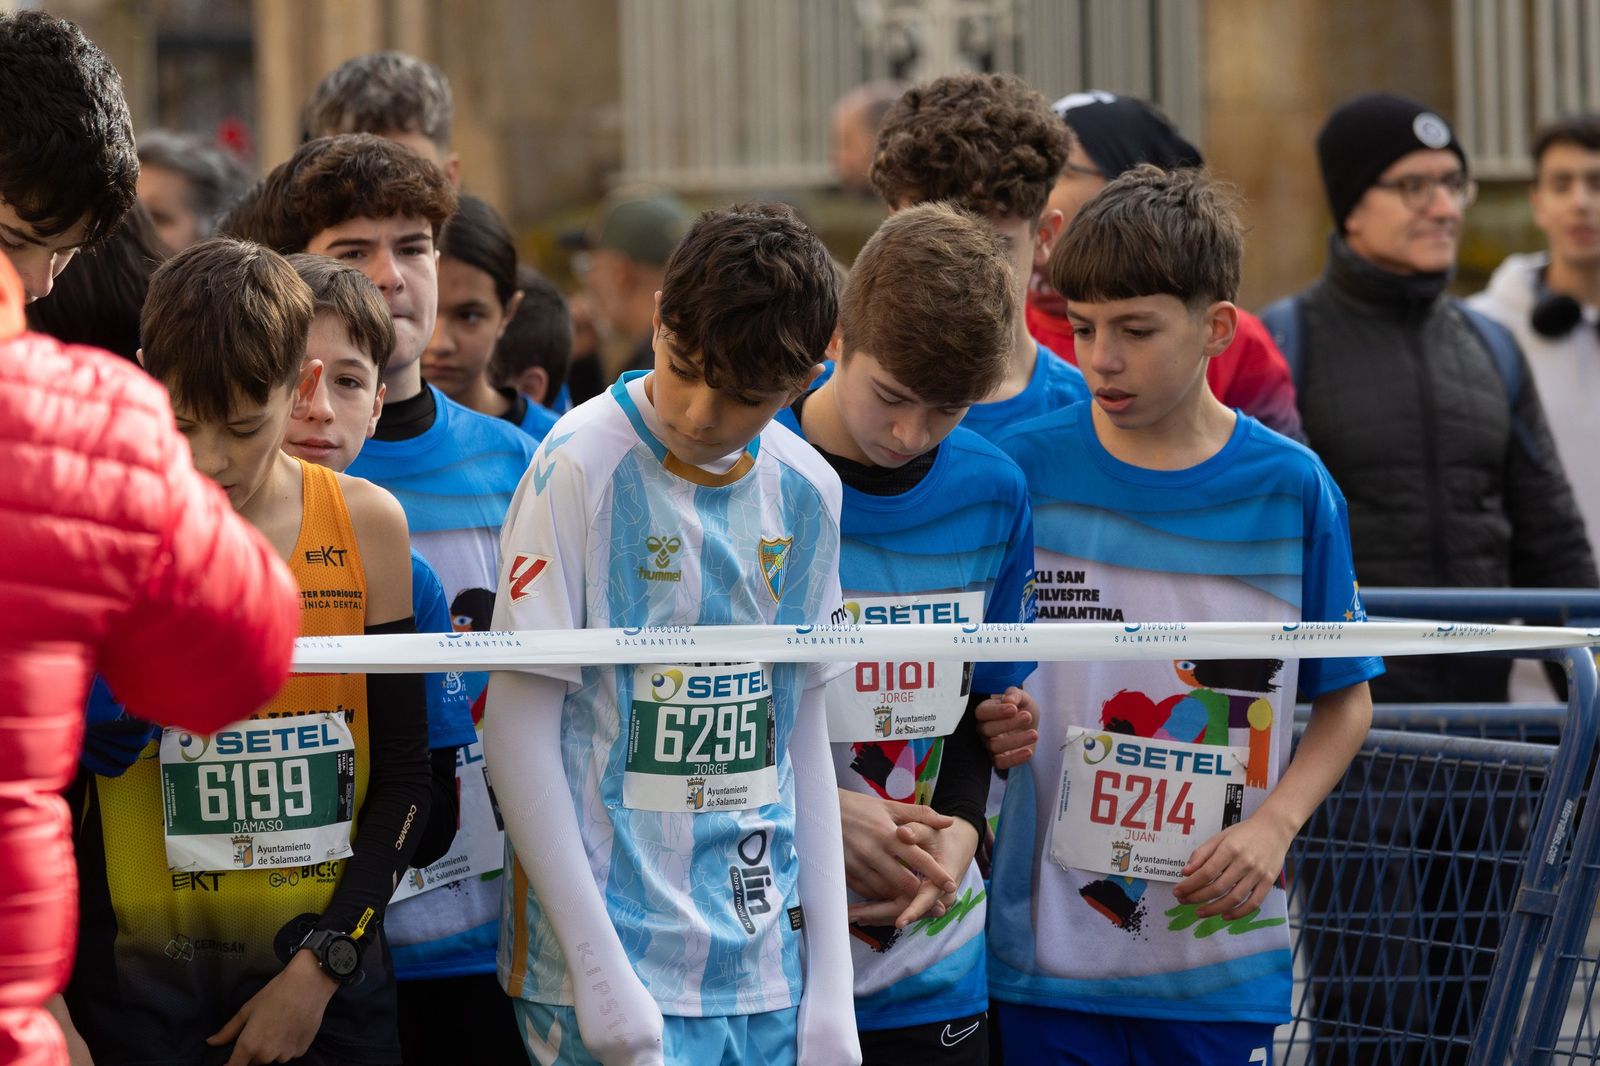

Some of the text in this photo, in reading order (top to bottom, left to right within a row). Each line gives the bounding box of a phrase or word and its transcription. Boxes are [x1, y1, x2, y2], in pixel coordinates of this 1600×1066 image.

[306, 546, 347, 566] EKT
[639, 566, 682, 582] hummel
[1057, 571, 1085, 584] SAN
[300, 590, 318, 599] TER
[334, 601, 363, 610] DENTAL
[865, 602, 969, 624] SETEL
[439, 639, 522, 648] SALMANTINA
[615, 638, 696, 646] SALMANTINA
[787, 636, 865, 645] SALMANTINA
[953, 636, 1029, 644] SALMANTINA
[1114, 634, 1188, 643] SALMANTINA
[1271, 633, 1342, 641] SALMANTINA
[687, 669, 768, 699] SETEL
[880, 692, 914, 703] JORGE
[895, 714, 936, 725] Ayuntamiento
[654, 702, 757, 763] 6295
[895, 727, 903, 735] de
[216, 724, 339, 755] SETEL
[1115, 743, 1232, 776] SETEL
[694, 763, 728, 775] JORGE
[198, 758, 312, 822] 6199
[707, 785, 748, 797] Ayuntamiento
[707, 797, 747, 807] de Salamanca
[1090, 770, 1195, 835] 6214
[233, 819, 283, 833] DÁMASO
[395, 804, 417, 850] COSMIC
[1124, 829, 1156, 843] JUAN
[257, 843, 311, 854] Ayuntamiento
[258, 854, 311, 865] de Salamanca
[424, 854, 468, 874] Ayuntamiento
[1134, 853, 1185, 868] Ayuntamiento
[426, 864, 471, 885] de Salamanca
[1133, 864, 1184, 878] de Salamanca
[172, 871, 226, 891] EKT
